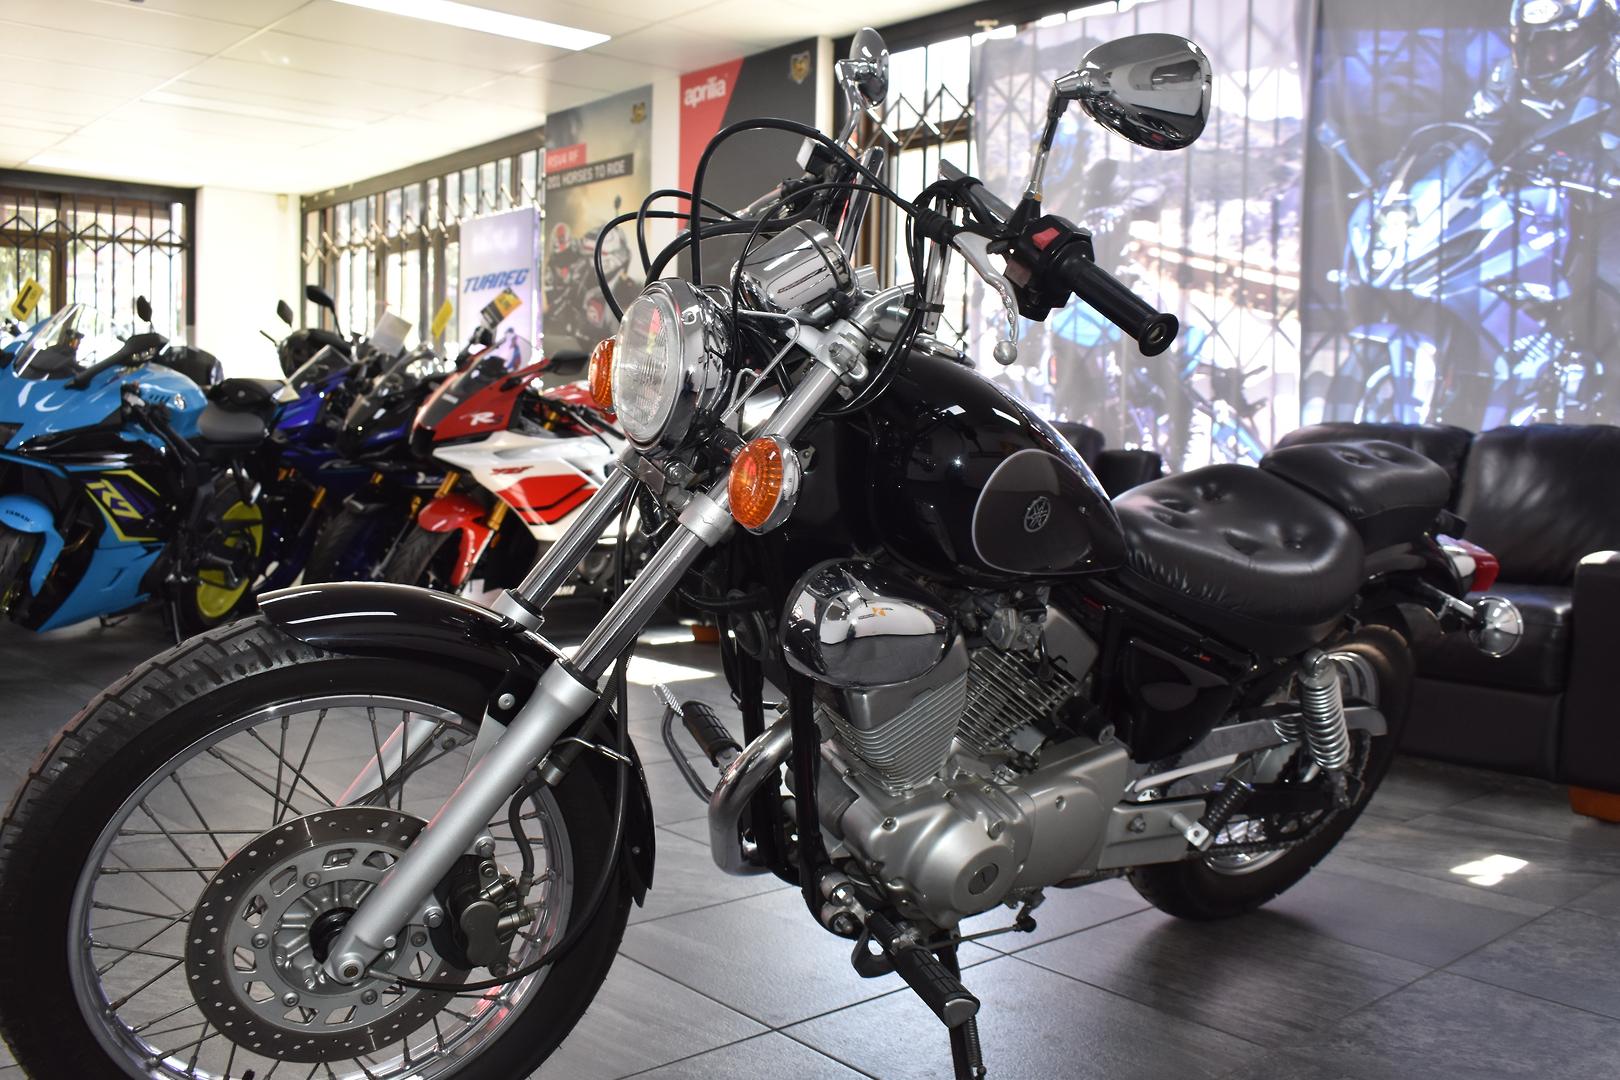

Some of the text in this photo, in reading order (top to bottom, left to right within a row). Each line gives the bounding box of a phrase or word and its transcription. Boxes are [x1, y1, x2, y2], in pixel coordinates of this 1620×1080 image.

[684, 76, 726, 108] aprilia
[562, 167, 594, 185] HORSES
[594, 163, 606, 179] TO
[606, 159, 625, 177] RIDE
[16, 284, 32, 314] L
